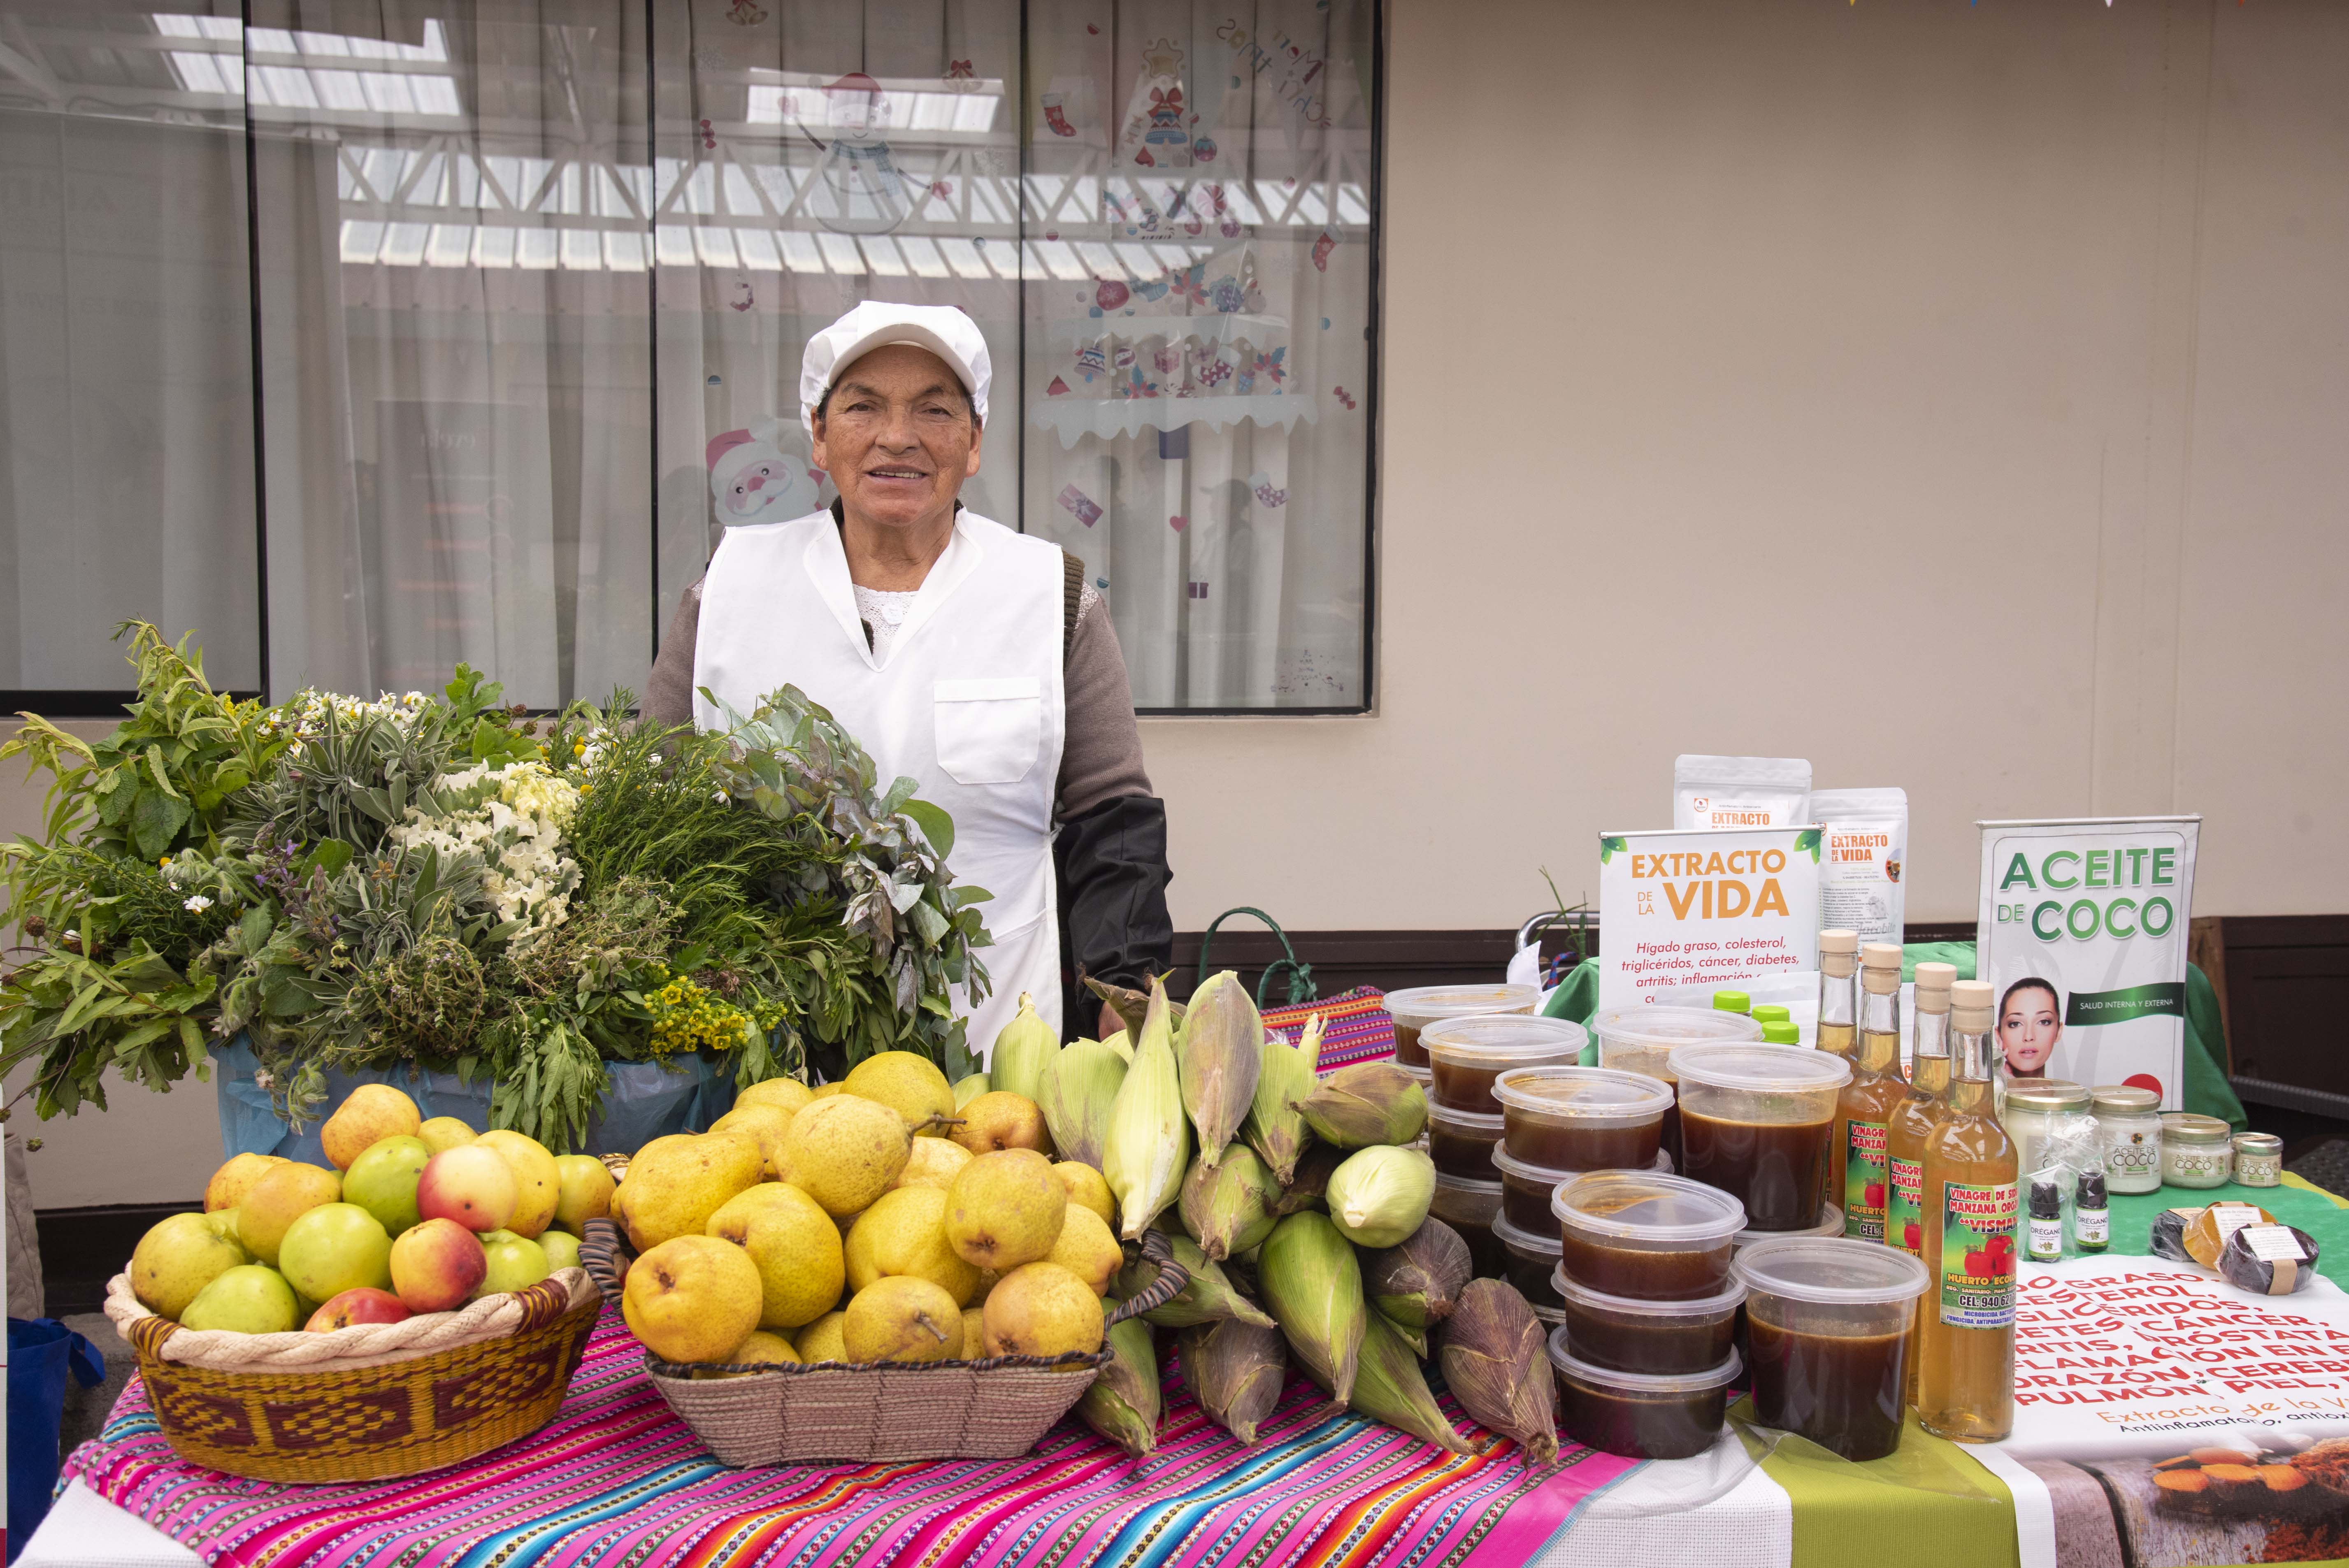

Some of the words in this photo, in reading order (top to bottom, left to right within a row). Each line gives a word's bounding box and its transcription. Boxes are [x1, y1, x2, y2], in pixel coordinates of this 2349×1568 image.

[1712, 813, 1770, 825] EXTRACTO
[1831, 835, 1888, 848] EXTRACTO
[1841, 849, 1873, 861] VIDA
[1631, 849, 1786, 878] EXTRACTO
[2000, 848, 2175, 890] ACEITE
[1638, 892, 1652, 902] DE
[1662, 878, 1789, 921] VIDA
[1638, 904, 1654, 915] LA
[1998, 904, 2024, 923] DE
[2032, 896, 2173, 941] COCO
[1636, 941, 1680, 955] Hígado
[1684, 941, 1720, 954] graso,
[1725, 936, 1786, 949] colesterol,
[1622, 957, 1694, 973] triglicéridos,
[1699, 956, 1741, 967] cáncer,
[1746, 953, 1799, 965] diabetes,
[1636, 976, 1677, 987] artritis;
[2145, 999, 2173, 1007] EXTERNA
[2113, 1153, 2156, 1166] COCO
[2176, 1159, 2212, 1170] COCO
[2241, 1165, 2272, 1175] COCO
[1950, 1188, 1991, 1201] VINAGRE
[1996, 1191, 2005, 1200] DE
[1950, 1201, 1996, 1214] MANZANA
[1947, 1273, 1989, 1285] HUERTO
[2065, 1273, 2220, 1289] GRASO,
[1960, 1296, 1979, 1306] CEL:
[1982, 1296, 1998, 1307] 940
[2141, 1314, 2329, 1331] CÁNCER,
[2261, 1345, 2329, 1356] EN
[2206, 1360, 2349, 1378] CEREB
[2224, 1378, 2340, 1394] PIEL,
[2096, 1405, 2229, 1423] Extracto
[2241, 1402, 2281, 1417] de
[2284, 1398, 2322, 1409] la
